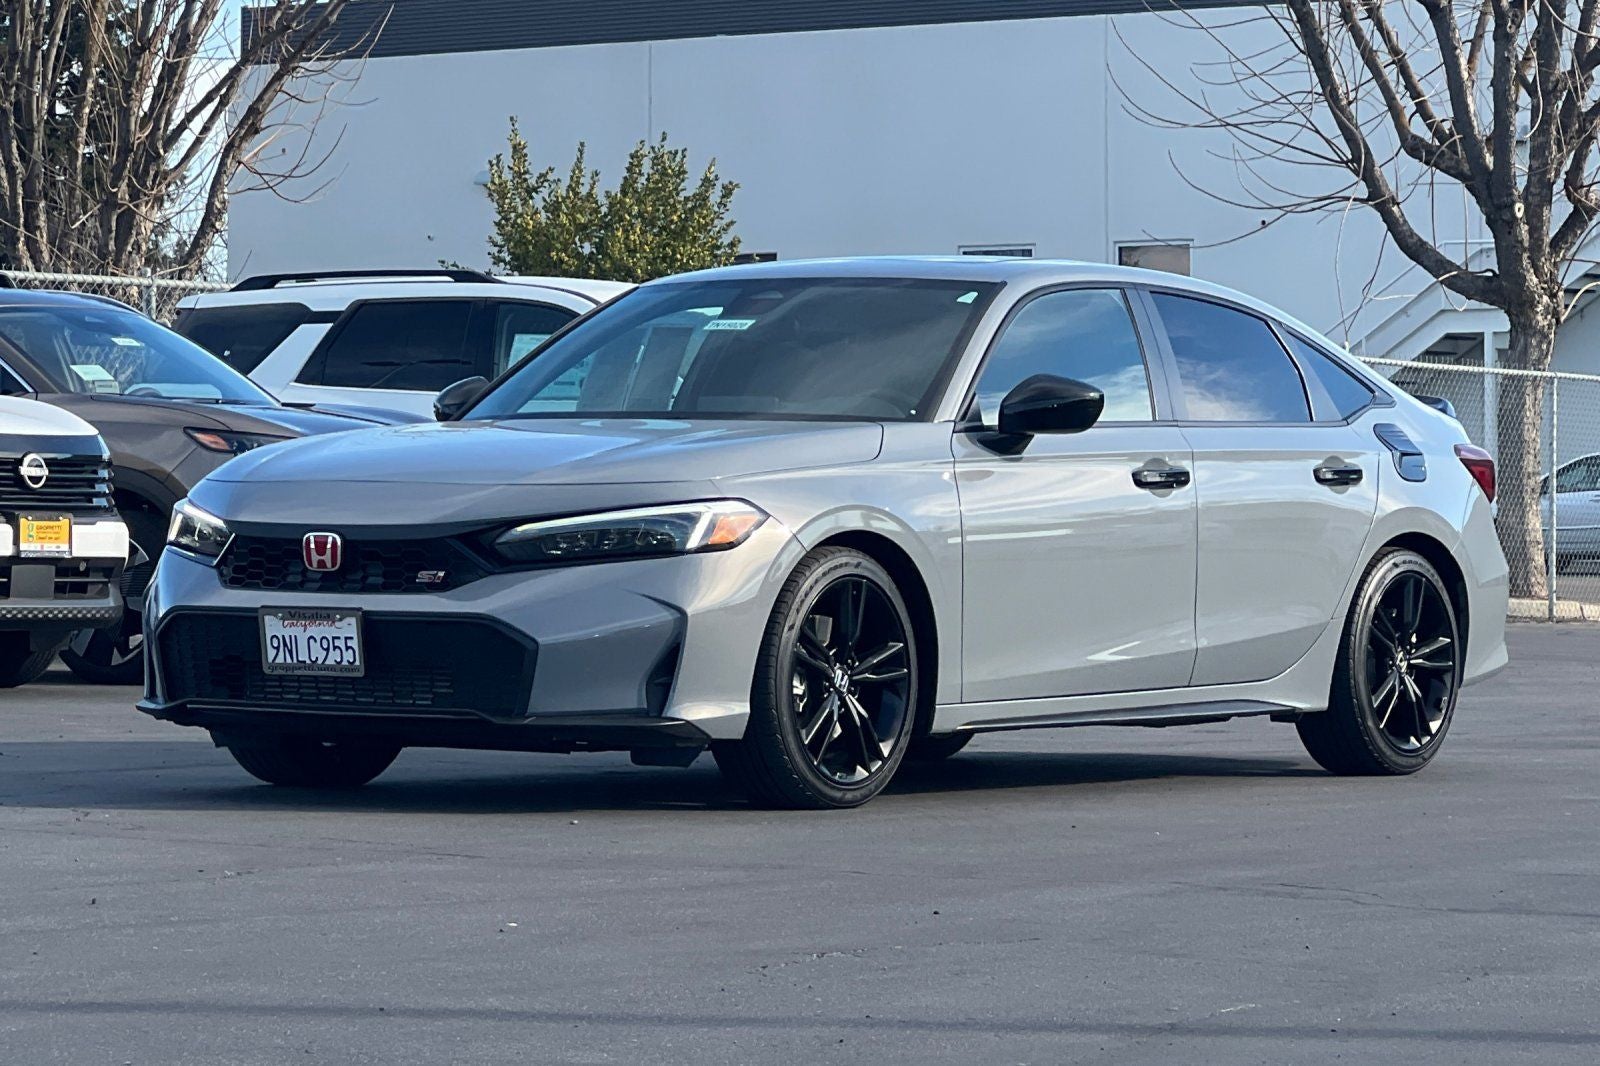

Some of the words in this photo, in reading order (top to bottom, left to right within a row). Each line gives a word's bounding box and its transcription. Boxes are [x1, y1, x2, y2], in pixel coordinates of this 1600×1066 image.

[288, 610, 331, 620] Visalia
[282, 620, 336, 632] California
[270, 634, 356, 665] 9NLC955
